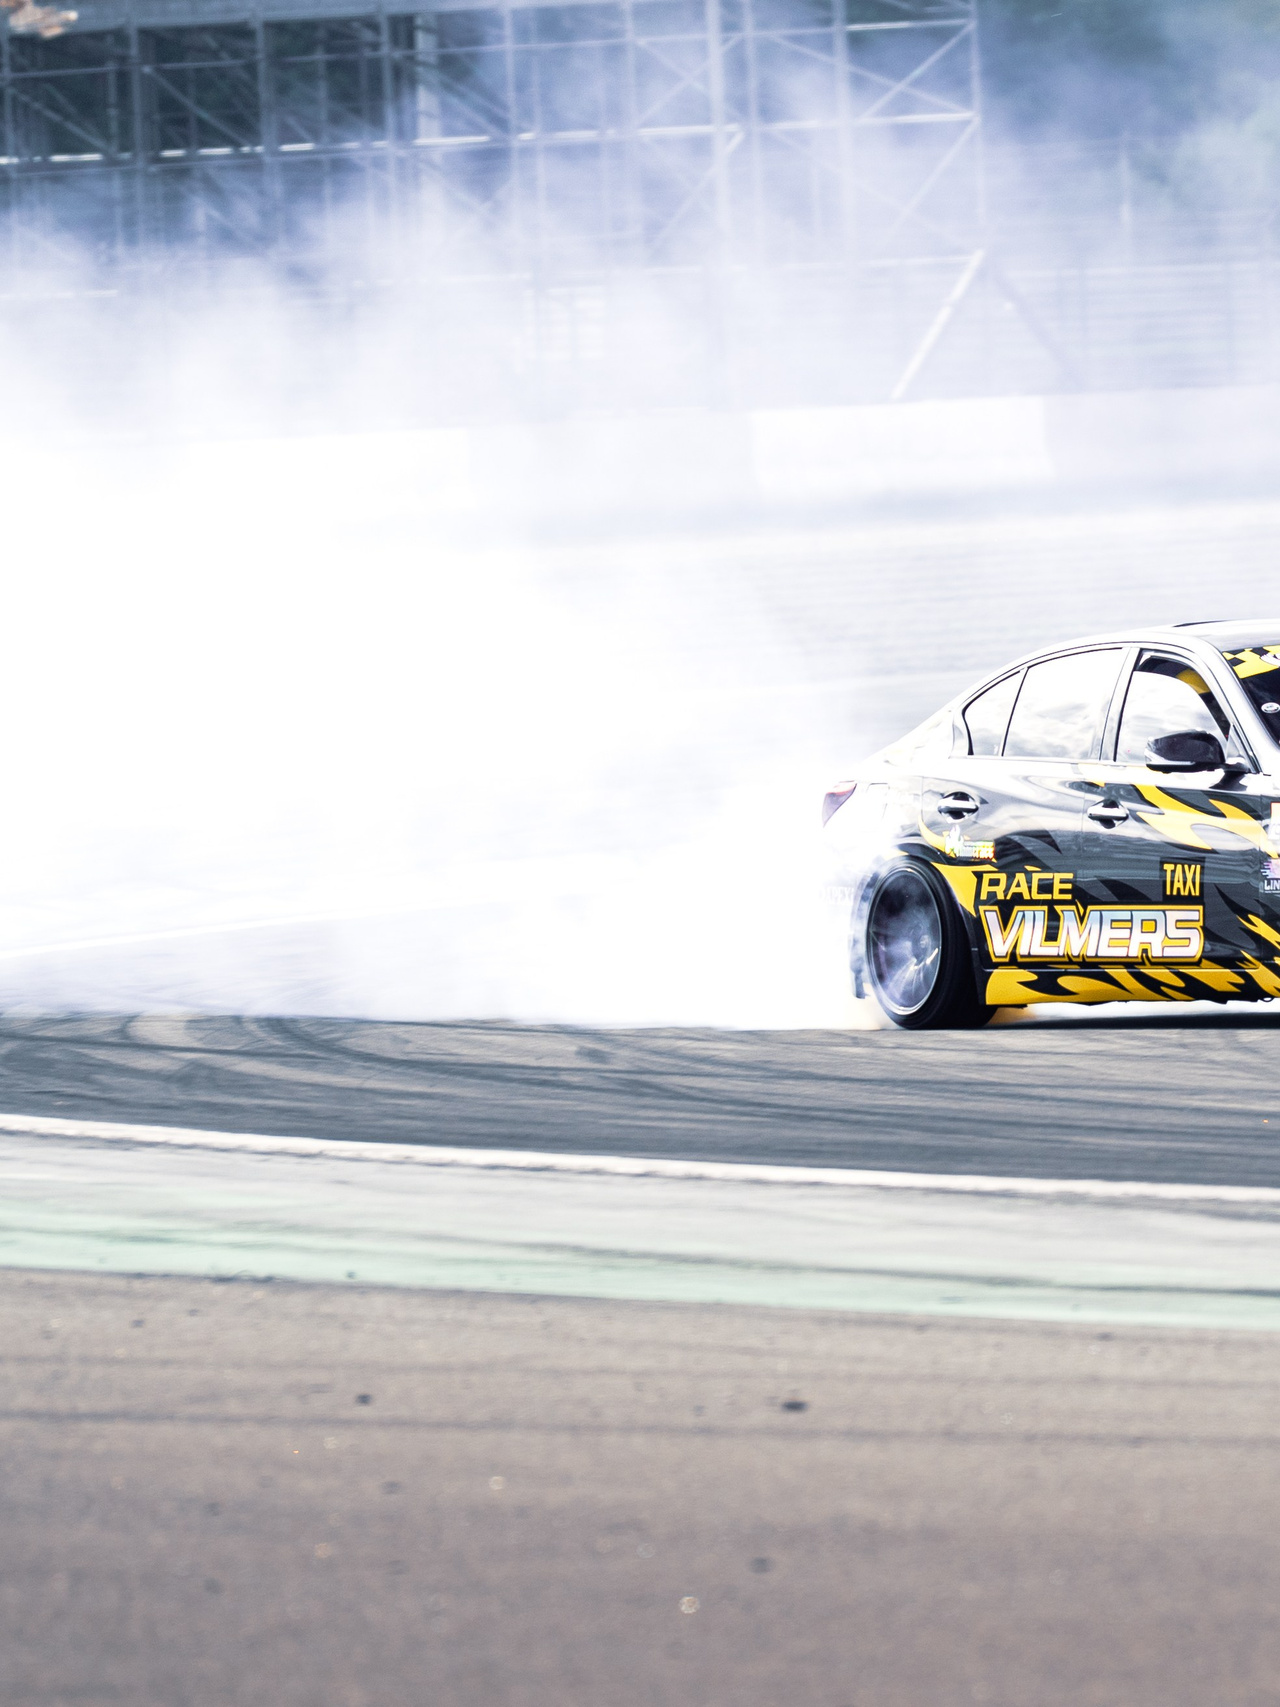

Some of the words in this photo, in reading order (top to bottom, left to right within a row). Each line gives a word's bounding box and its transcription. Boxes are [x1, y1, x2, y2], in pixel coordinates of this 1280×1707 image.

[980, 872, 1074, 900] RACE
[1163, 863, 1201, 896] TAXI
[980, 906, 1203, 961] VILMERS
